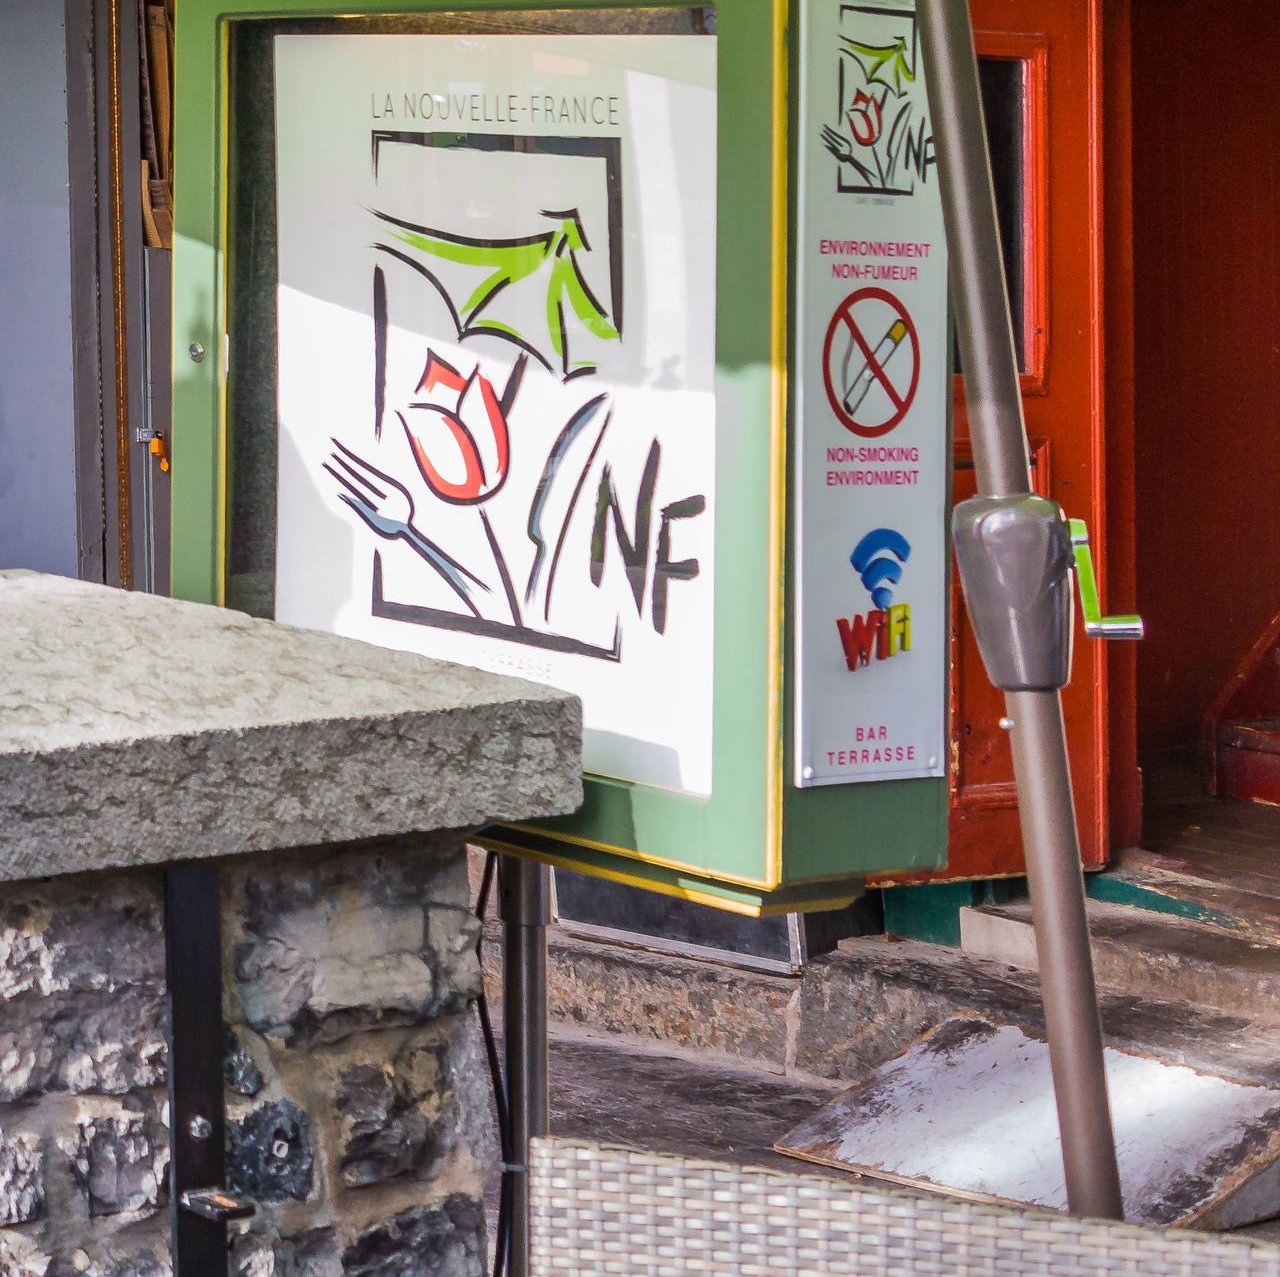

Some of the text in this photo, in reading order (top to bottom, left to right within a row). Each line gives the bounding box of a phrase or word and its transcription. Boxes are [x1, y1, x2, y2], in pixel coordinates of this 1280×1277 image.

[371, 92, 619, 125] LA NOUVELLE-FRANCE
[819, 239, 930, 258] ENVIRONNEMENT
[832, 264, 918, 280] NON-FUMEUR
[826, 447, 919, 462] NON-SMOKING
[826, 470, 919, 486] ENVIRONMENT
[590, 435, 706, 636] NF
[856, 726, 887, 741] BAR
[827, 746, 915, 766] TERRASSE
